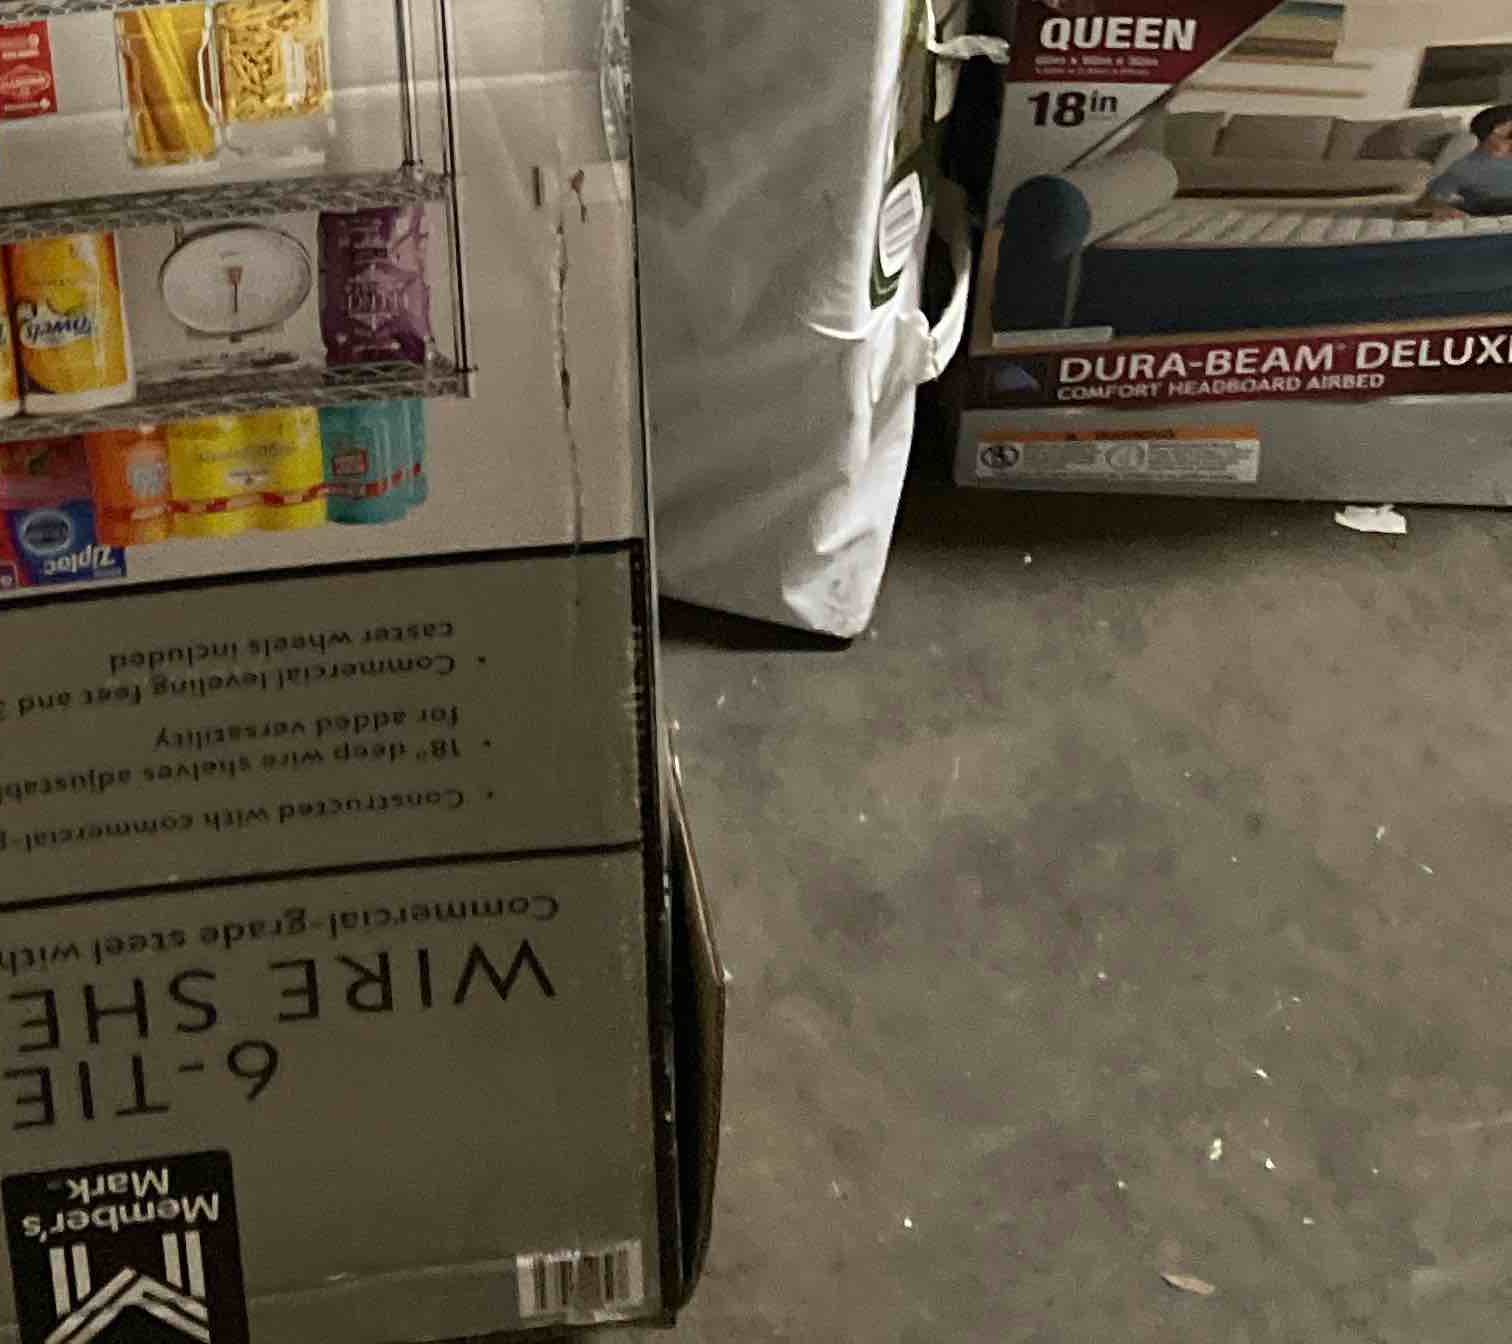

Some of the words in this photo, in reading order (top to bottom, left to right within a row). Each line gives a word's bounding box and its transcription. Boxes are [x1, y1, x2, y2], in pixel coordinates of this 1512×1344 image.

[1038, 16, 1198, 54] QUEEN
[1059, 343, 1334, 385] DURA-BEAM
[1355, 333, 1512, 372] DELUX
[1057, 382, 1162, 402] COMFORT
[1168, 376, 1301, 397] HEADBOARD
[1306, 373, 1385, 392] AIRBED
[42, 543, 116, 577] Ziploc
[110, 642, 238, 675] included
[249, 631, 352, 657] wheels
[153, 672, 267, 697] leveling
[278, 655, 455, 689] Commercial
[18, 691, 71, 717] and
[84, 684, 142, 705] feet
[315, 711, 407, 737] added
[421, 706, 459, 727] for
[156, 721, 305, 750] versatility
[262, 749, 324, 767] wire
[333, 743, 406, 762] deep
[143, 757, 251, 782] shelves
[212, 808, 268, 831] with
[279, 790, 464, 824] Constructed
[200, 895, 559, 950] Commercial-grade
[93, 931, 186, 966] steel
[271, 938, 556, 1023] WIRE
[65, 1165, 171, 1207] Mark
[22, 1193, 219, 1243] Member's
